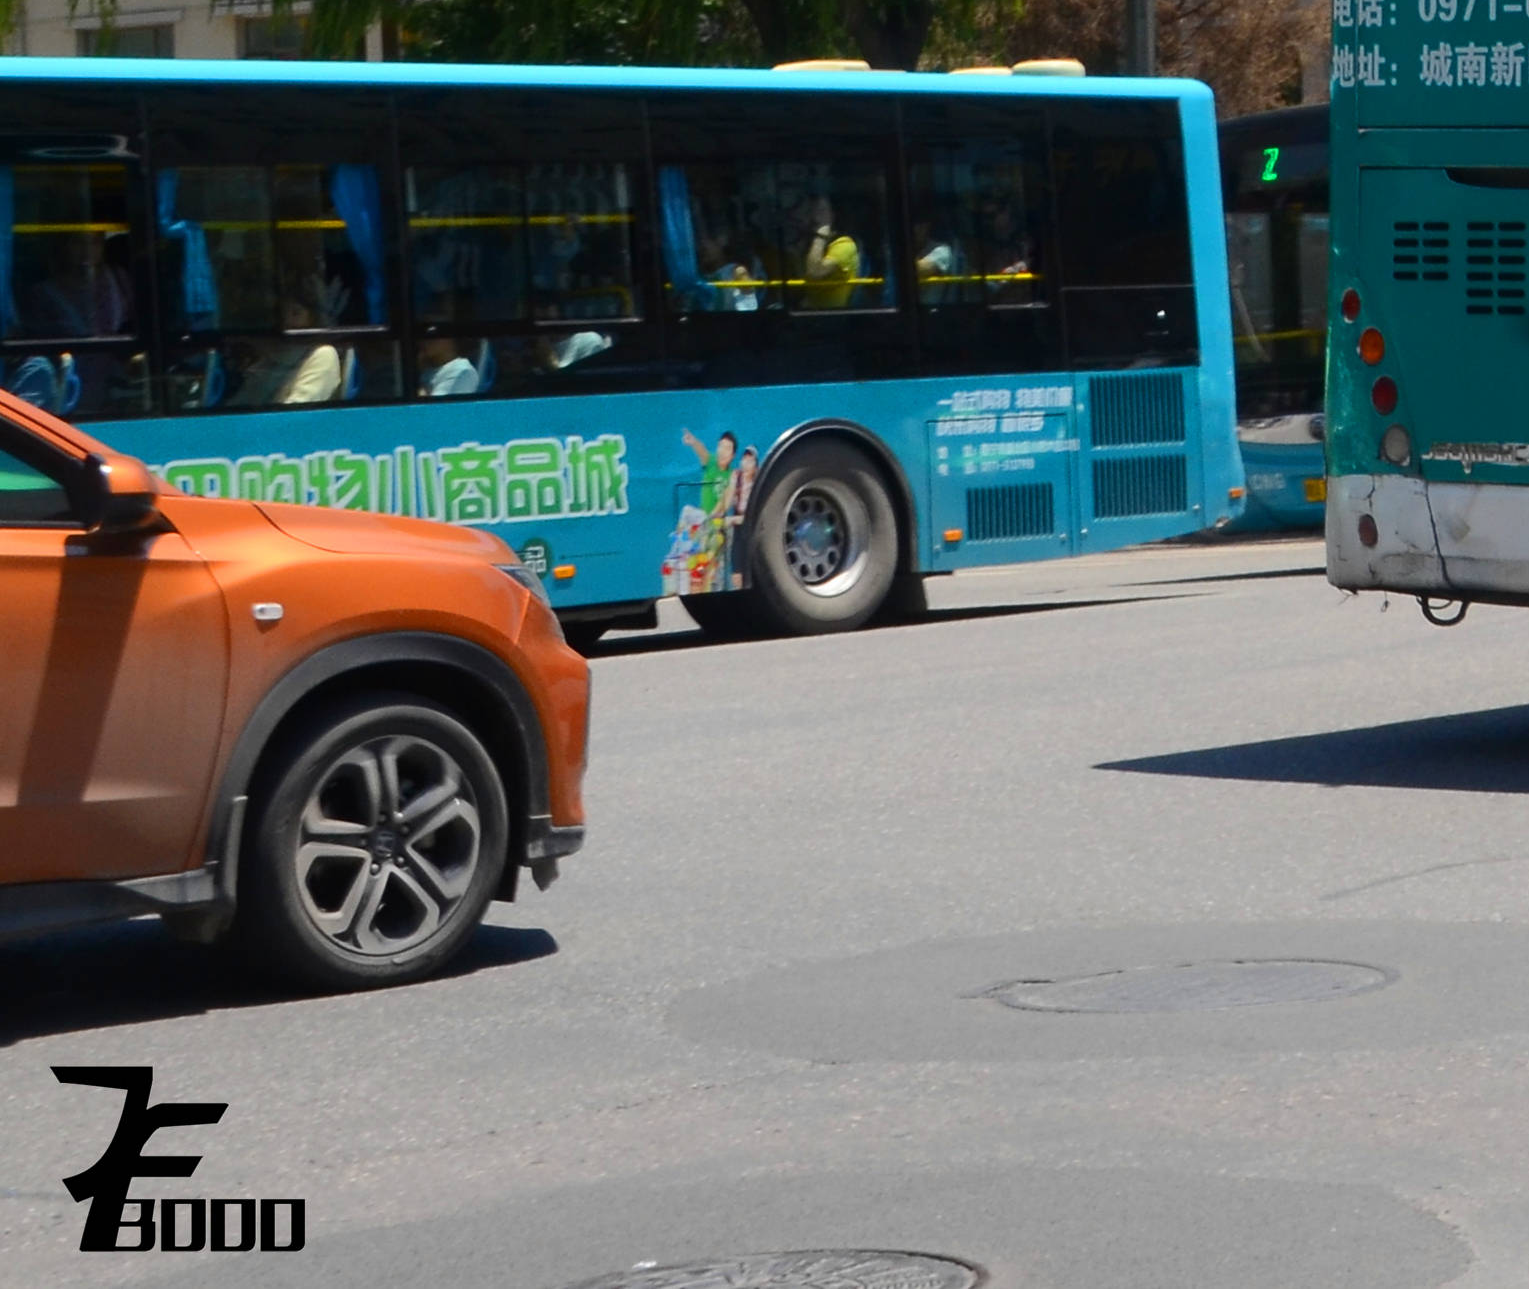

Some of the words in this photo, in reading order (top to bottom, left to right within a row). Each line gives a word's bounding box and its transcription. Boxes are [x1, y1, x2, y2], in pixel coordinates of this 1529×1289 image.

[1262, 147, 1280, 181] 2
[150, 434, 628, 526] 购物小商品城
